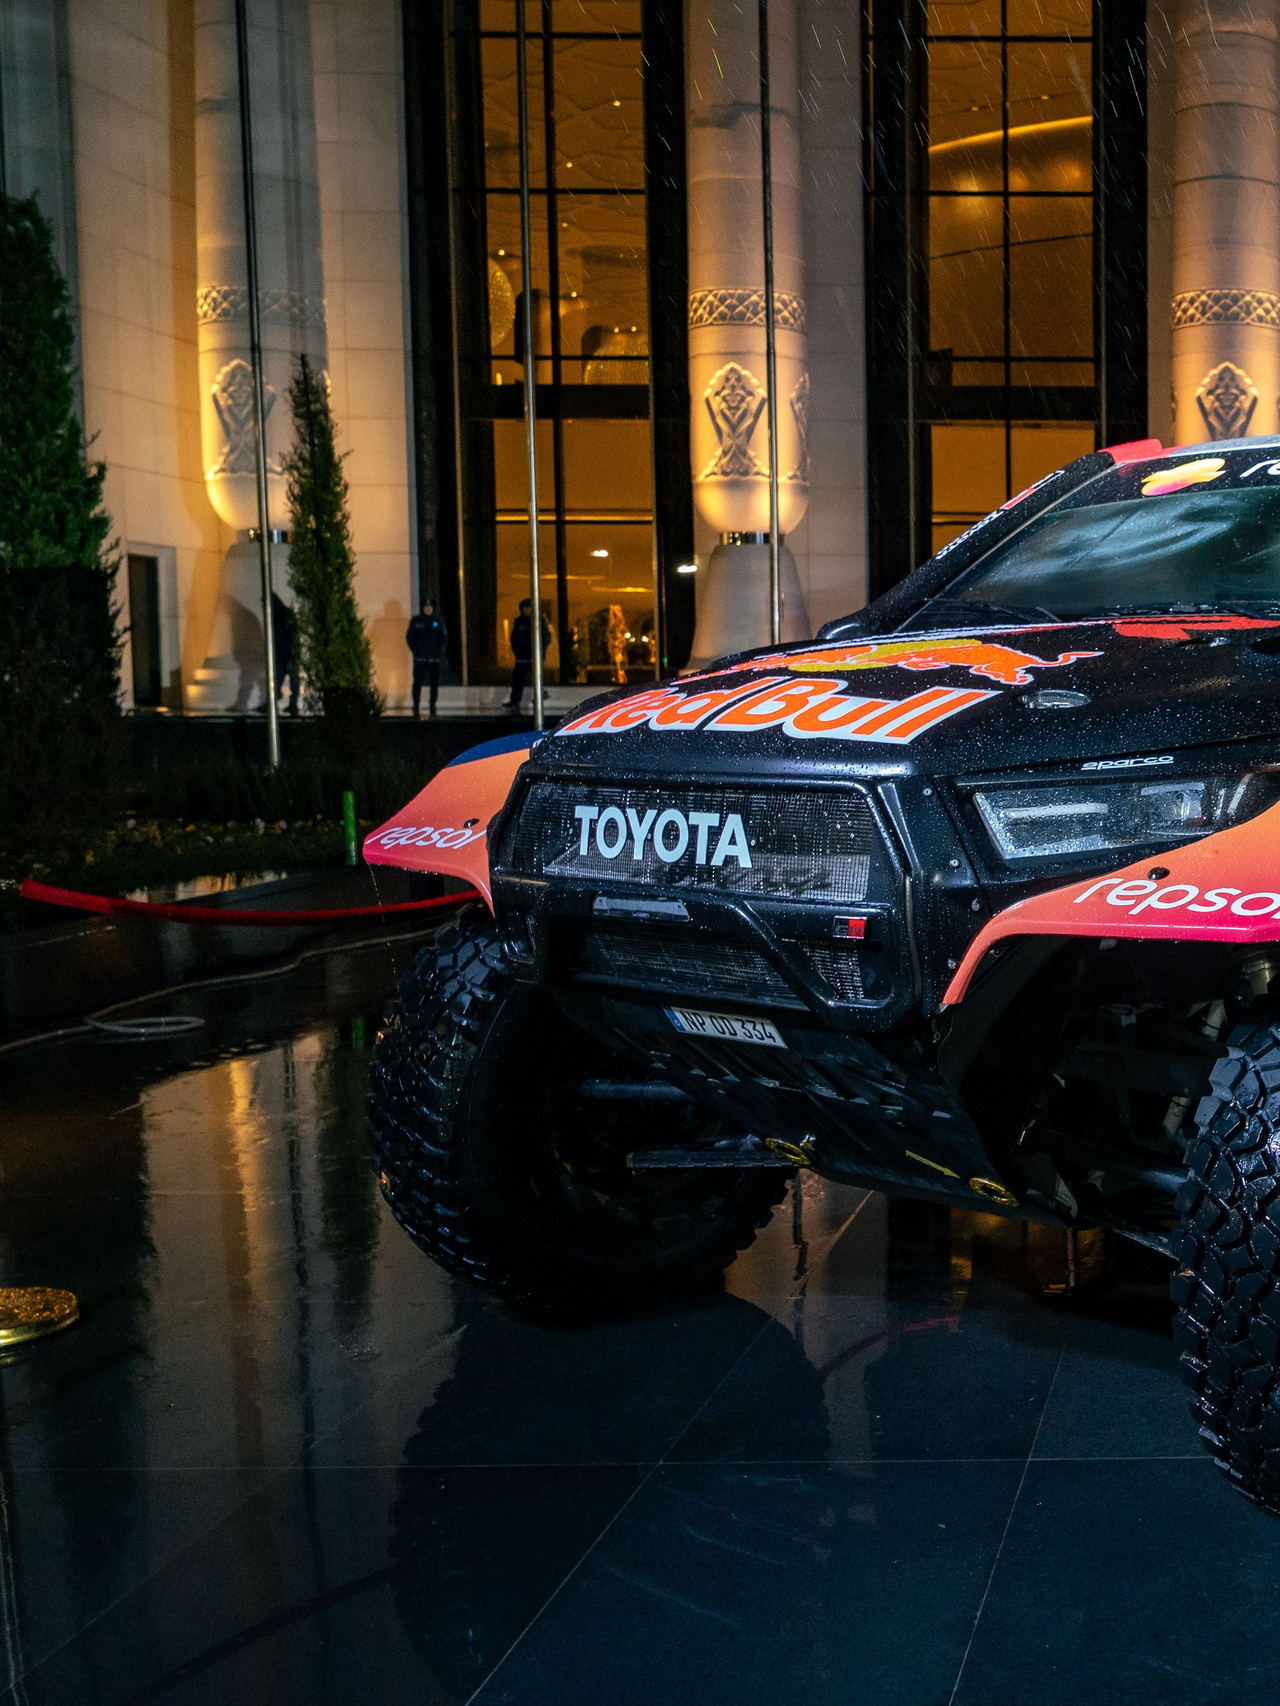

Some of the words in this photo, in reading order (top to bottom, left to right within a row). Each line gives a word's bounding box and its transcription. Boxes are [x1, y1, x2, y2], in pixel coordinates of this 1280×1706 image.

[555, 675, 792, 737] Red
[703, 677, 1003, 744] Bull
[1081, 755, 1174, 770] sparco
[366, 826, 486, 850] repsol
[574, 804, 753, 868] TOYOTA
[680, 1010, 706, 1033] NP
[733, 1018, 777, 1043] 334
